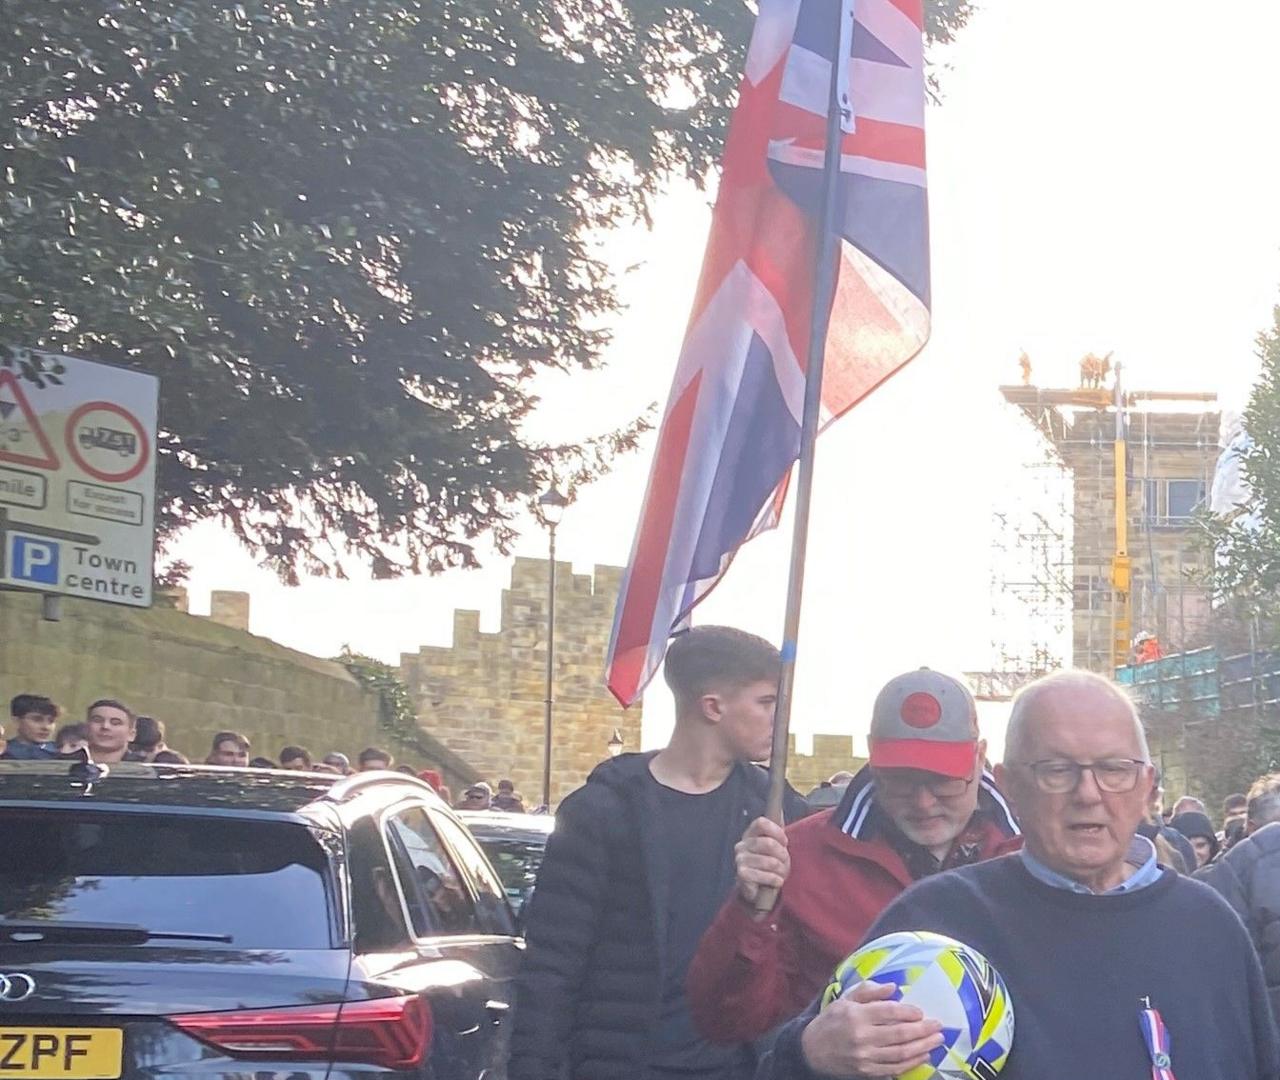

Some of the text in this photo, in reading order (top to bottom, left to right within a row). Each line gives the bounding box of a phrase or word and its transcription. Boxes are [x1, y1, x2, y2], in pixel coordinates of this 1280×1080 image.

[23, 542, 52, 577] P
[72, 547, 137, 575] Town
[65, 573, 144, 599] centre
[0, 1034, 92, 1071] ZPF
